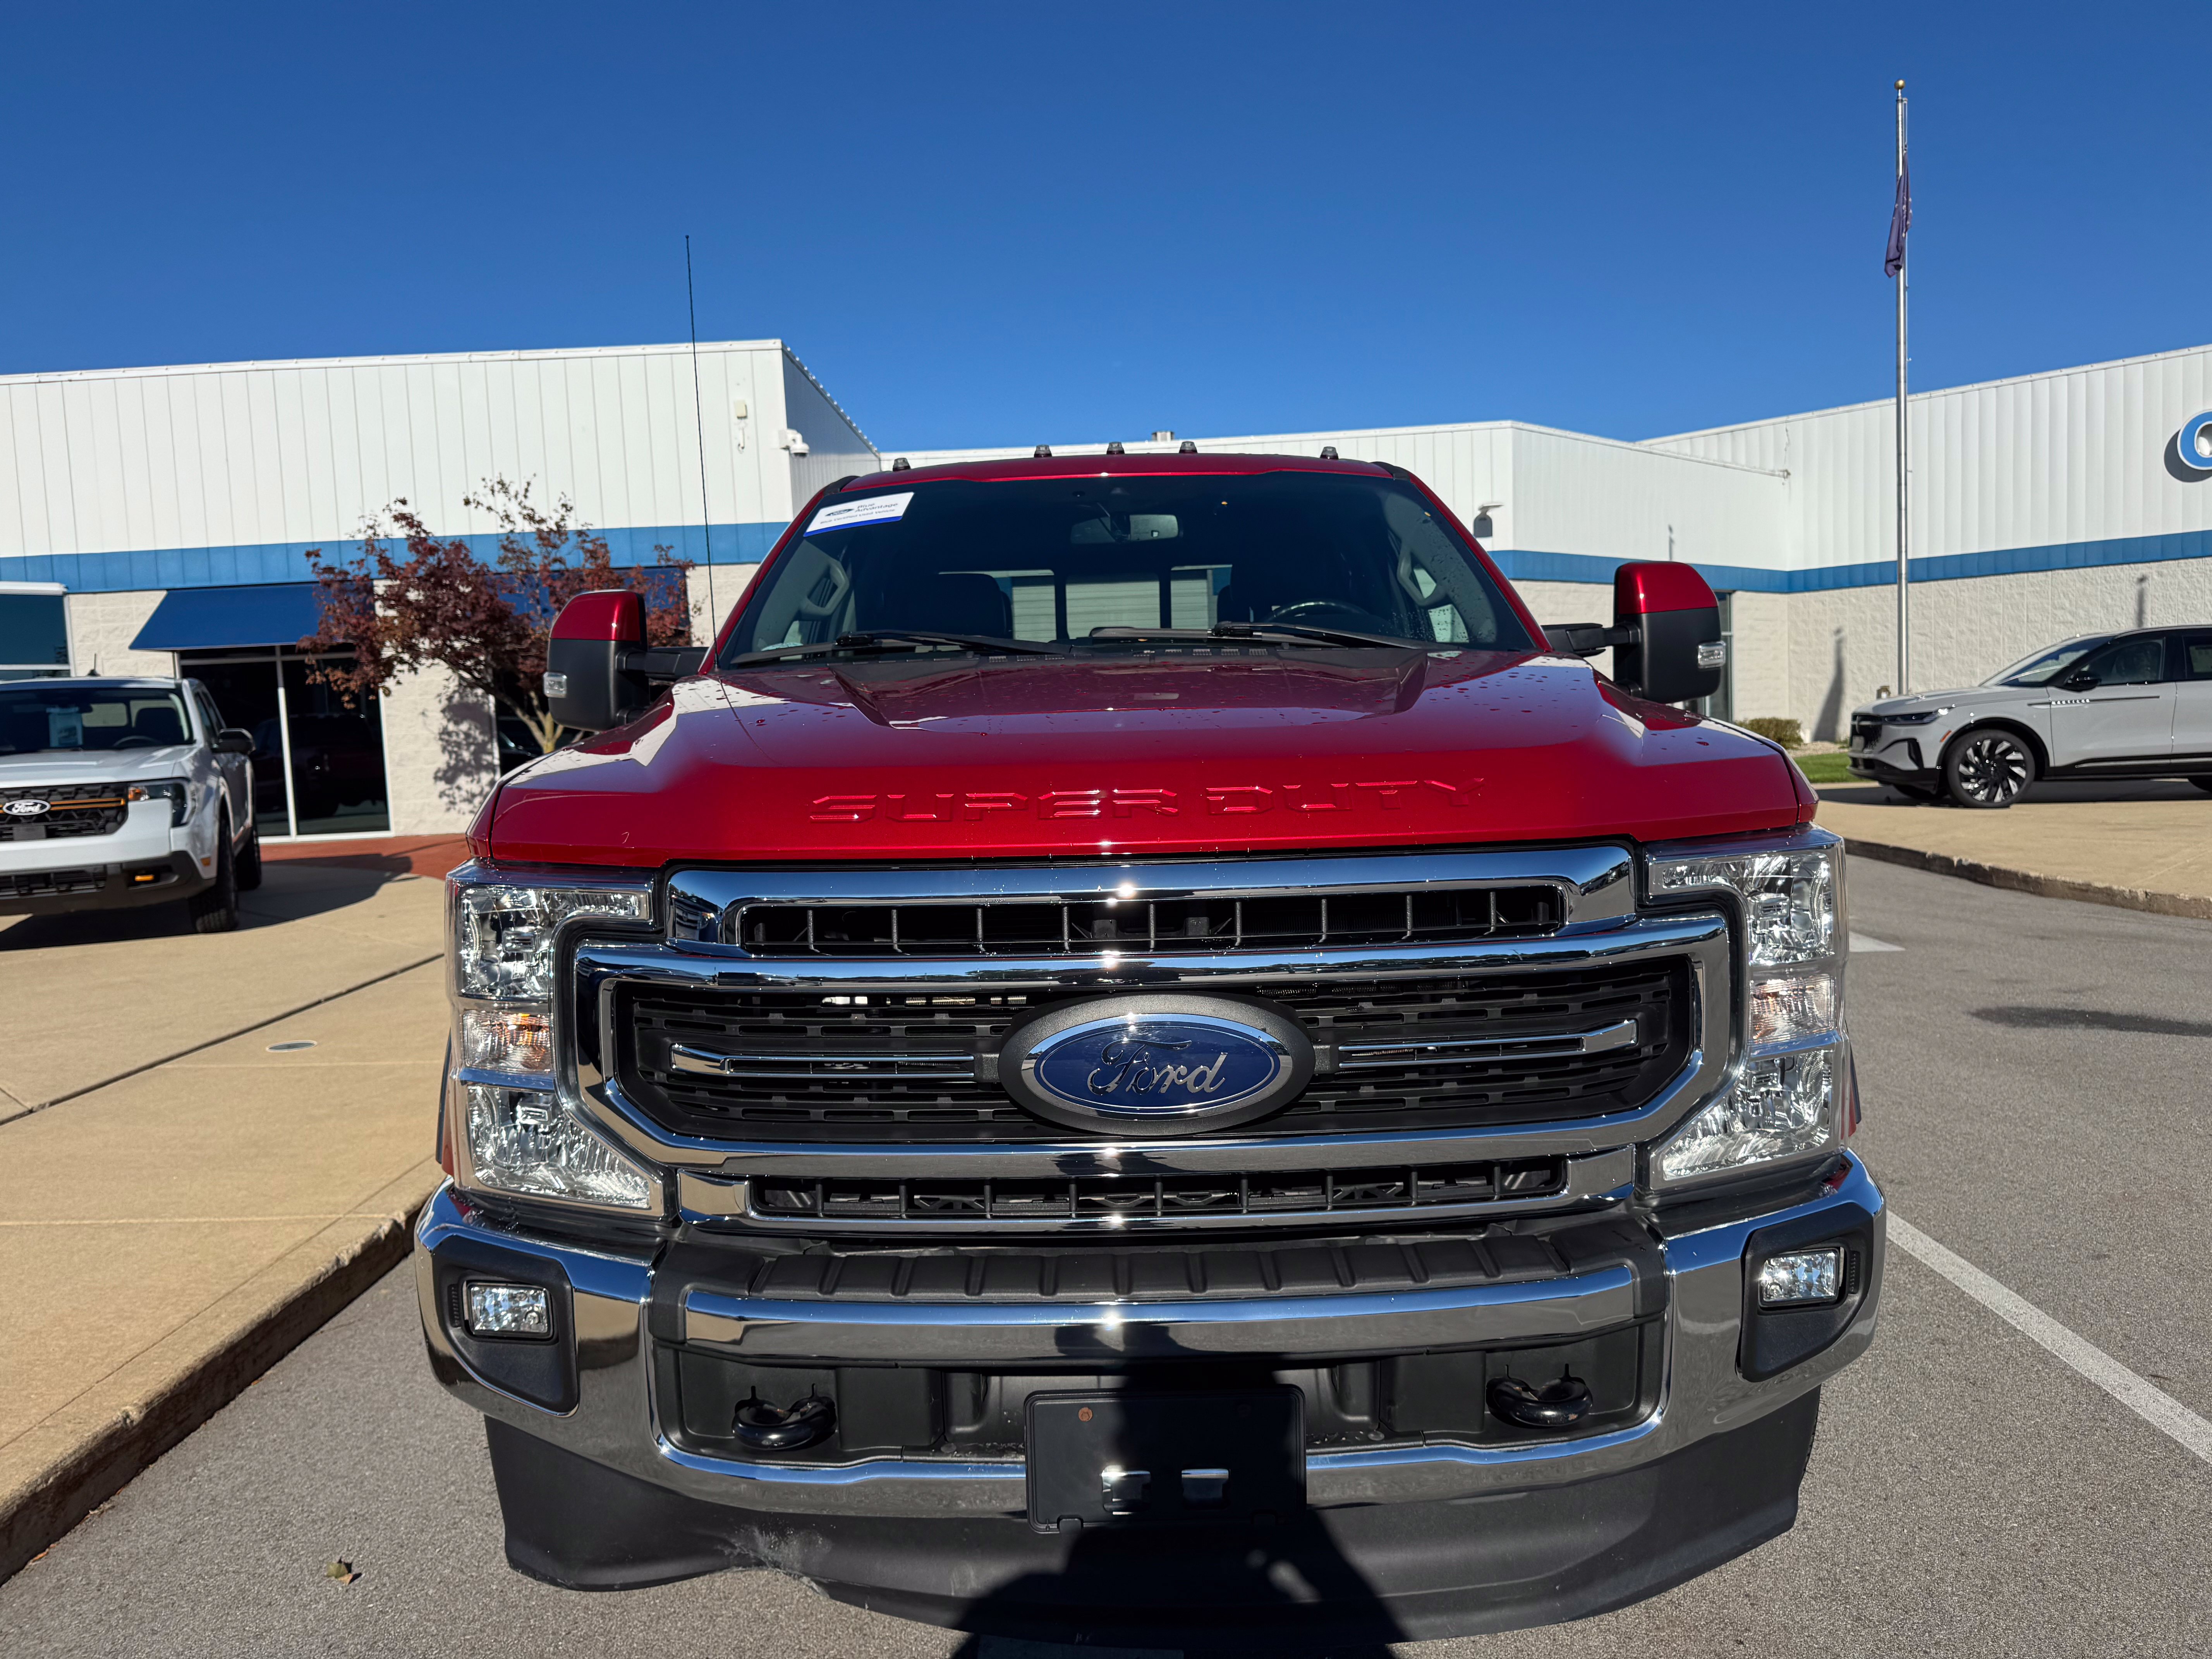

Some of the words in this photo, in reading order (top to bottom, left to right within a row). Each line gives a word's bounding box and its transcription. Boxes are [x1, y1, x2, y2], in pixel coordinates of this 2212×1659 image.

[855, 503, 898, 513] Advantage
[12, 802, 42, 813] Ford
[809, 788, 1179, 824] SUPER
[1206, 778, 1485, 815] DUTY
[1088, 1039, 1228, 1096] Ford
